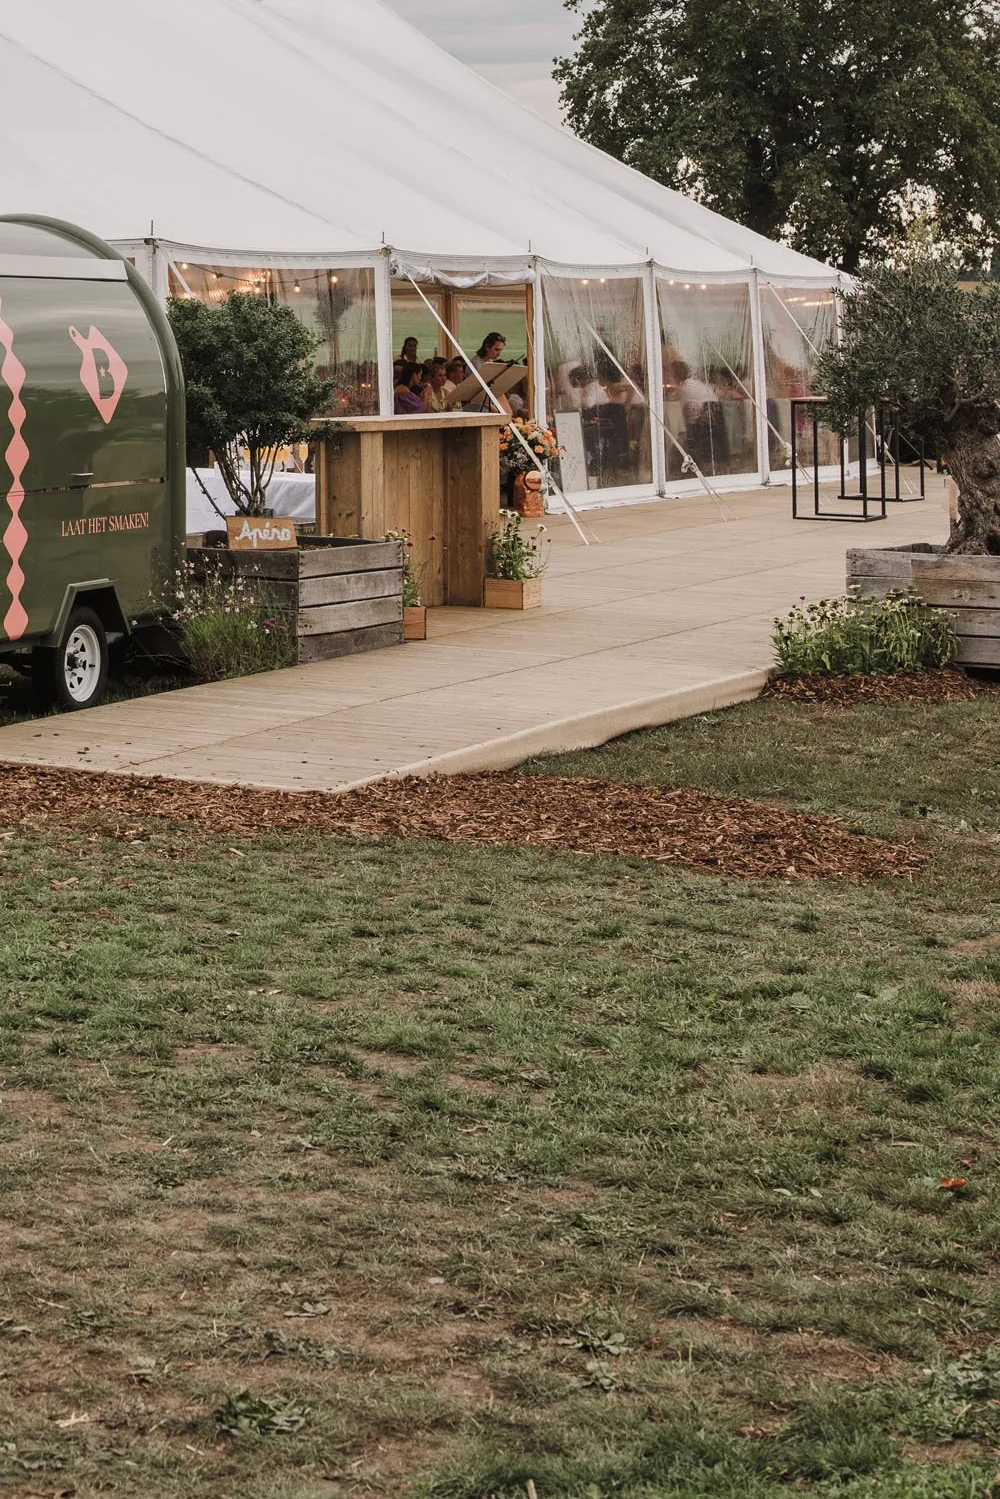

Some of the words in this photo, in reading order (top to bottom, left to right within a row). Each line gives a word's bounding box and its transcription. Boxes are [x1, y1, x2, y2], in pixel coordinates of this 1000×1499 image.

[61, 519, 87, 537] LAAT
[88, 516, 107, 534] HET
[108, 512, 149, 532] SMAKEN!
